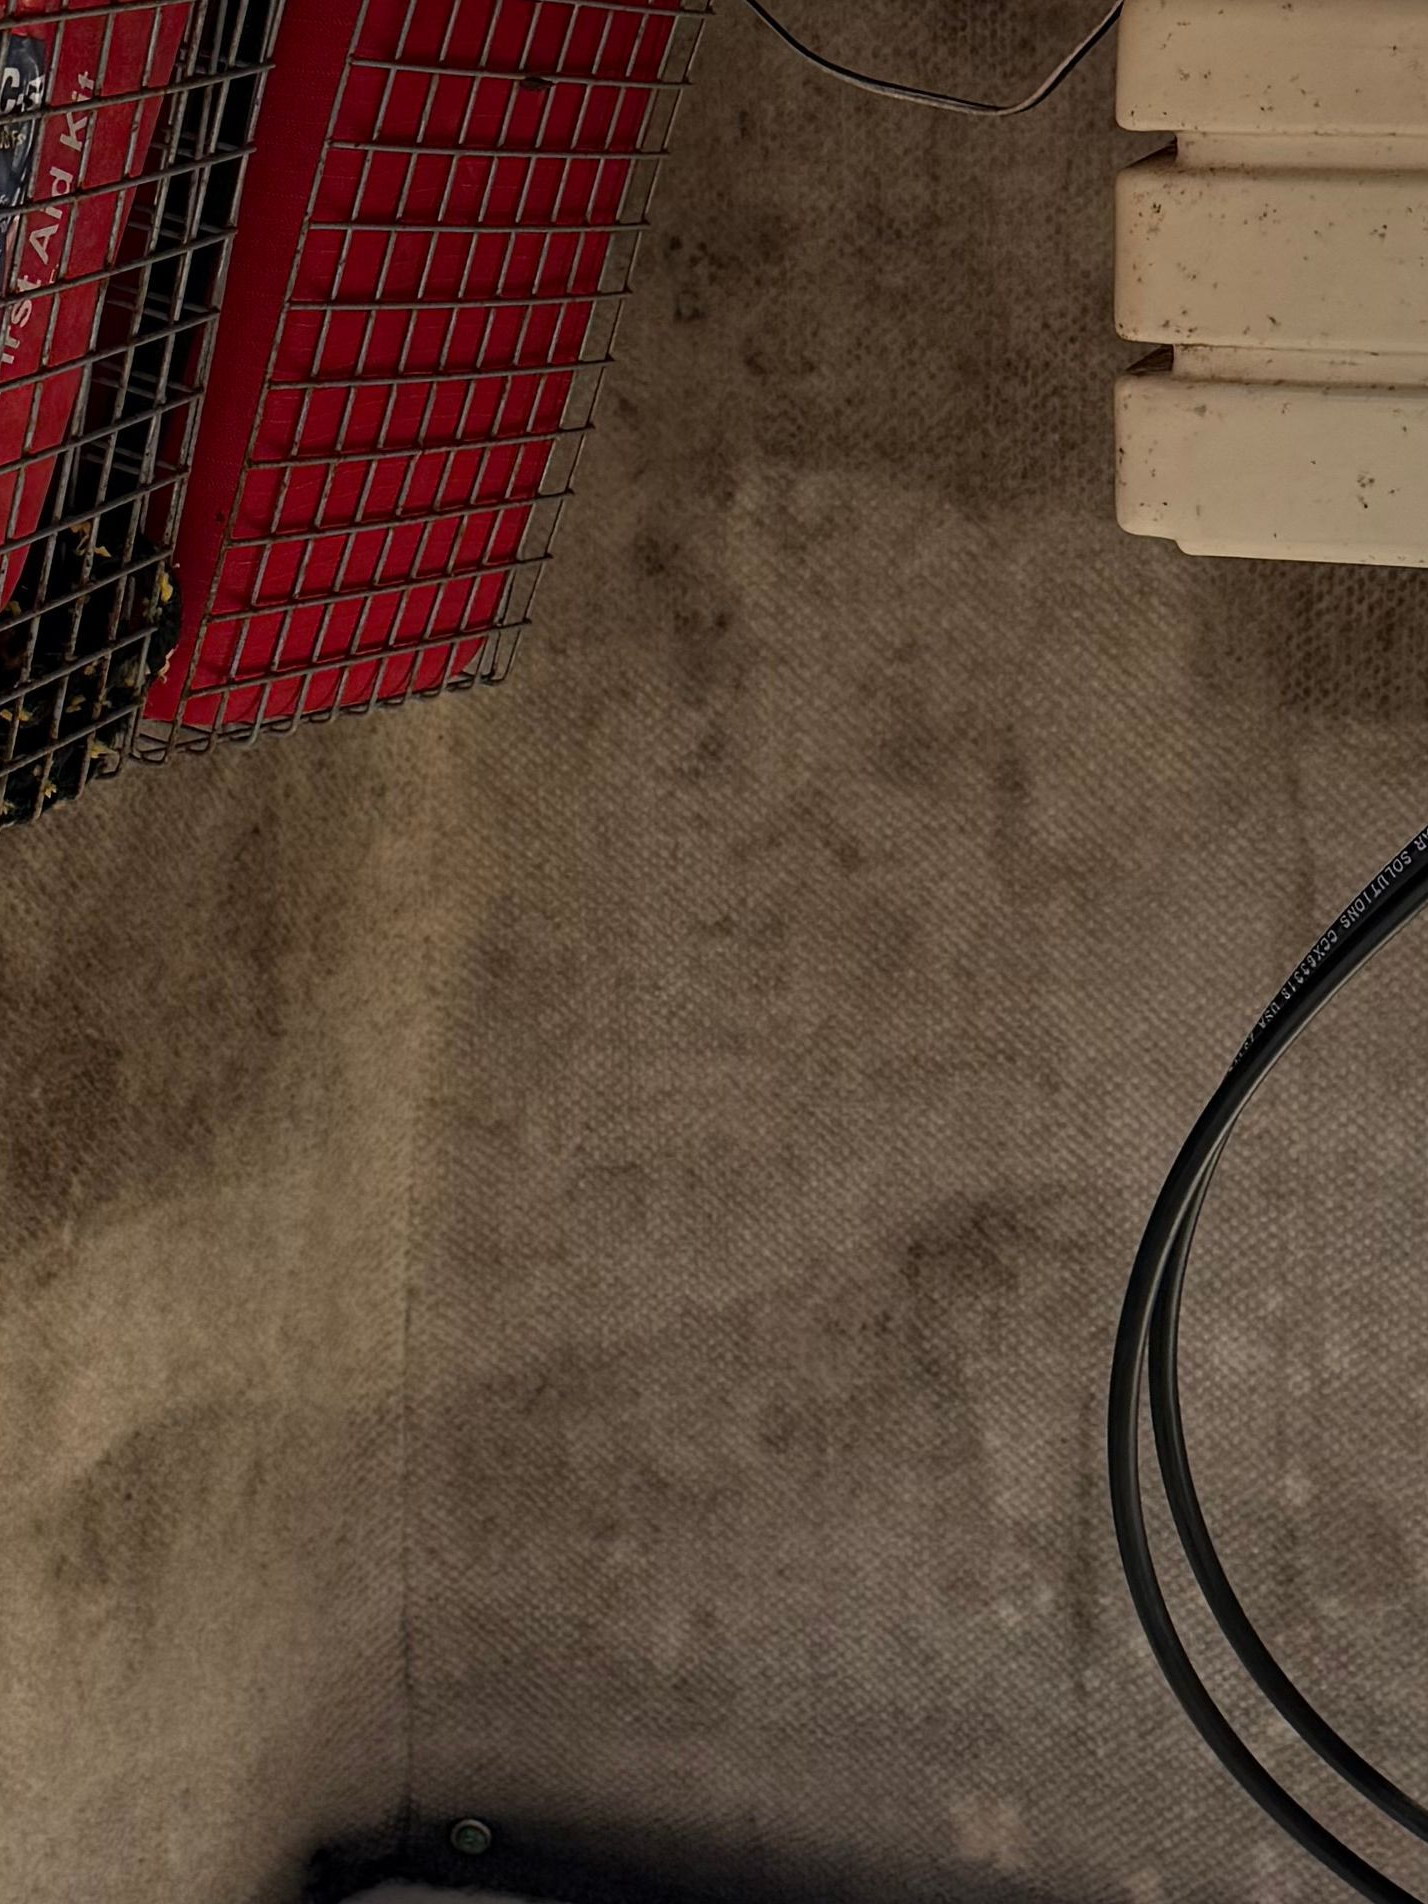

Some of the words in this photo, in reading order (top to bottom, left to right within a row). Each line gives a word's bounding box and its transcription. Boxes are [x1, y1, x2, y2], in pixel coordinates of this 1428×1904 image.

[29, 167, 73, 265] Aid
[60, 71, 96, 152] Kit
[1340, 851, 1412, 928] SOLUTIONS
[1258, 1002, 1281, 1029] USA
